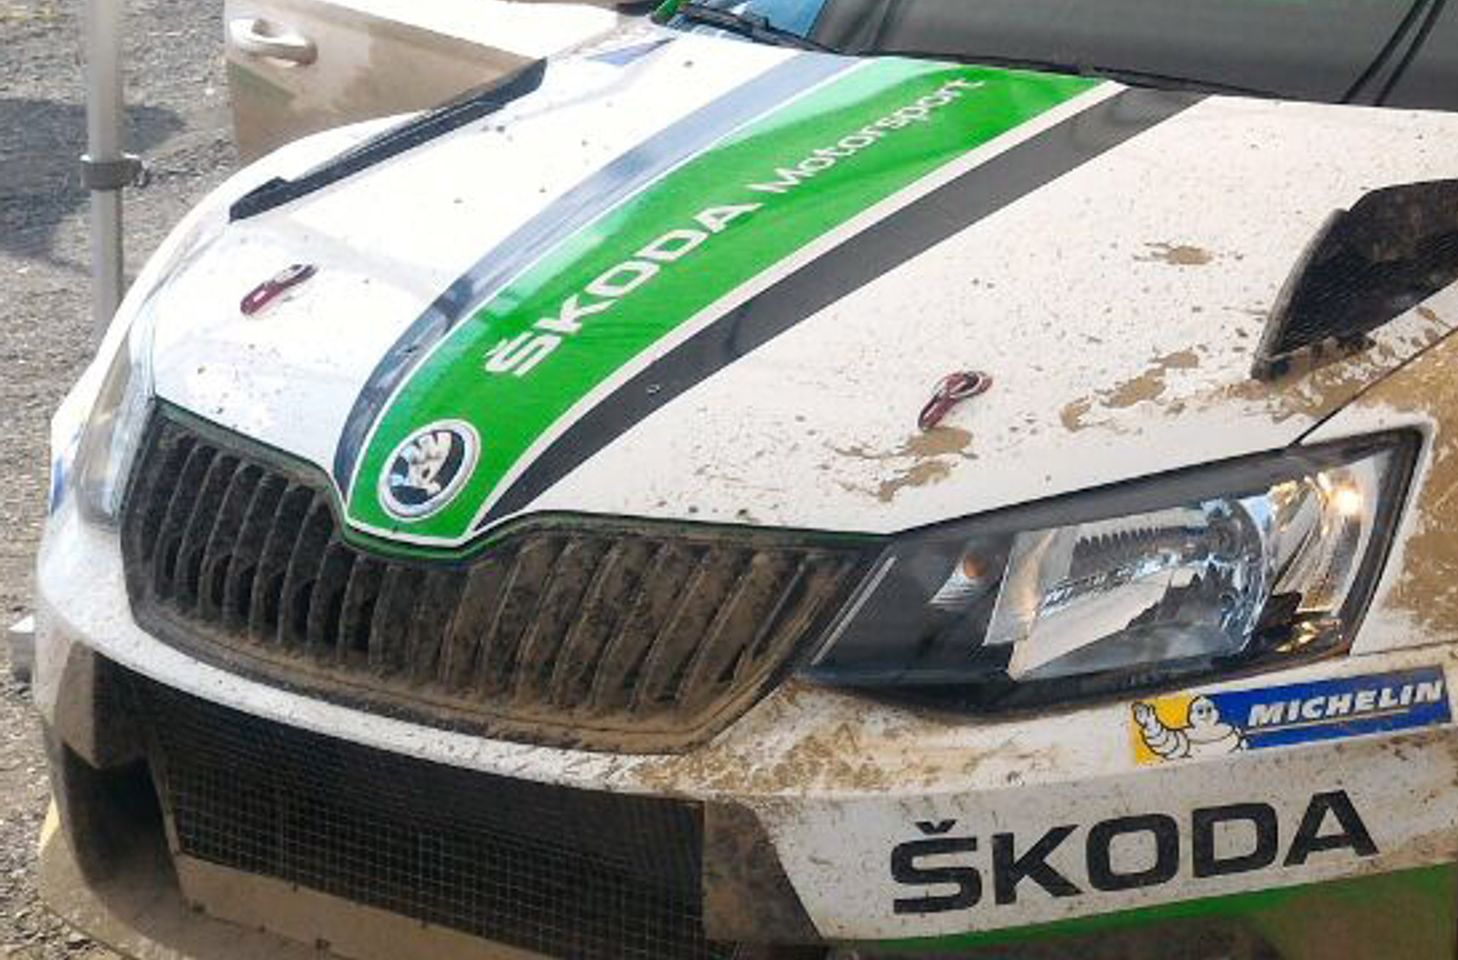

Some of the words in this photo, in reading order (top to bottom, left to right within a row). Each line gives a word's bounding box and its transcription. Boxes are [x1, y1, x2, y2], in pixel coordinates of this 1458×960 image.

[484, 201, 764, 377] ŠKODA
[746, 77, 986, 194] Motorsport
[1247, 680, 1444, 728] MICHELIN
[890, 788, 1381, 915] ŠKODA
